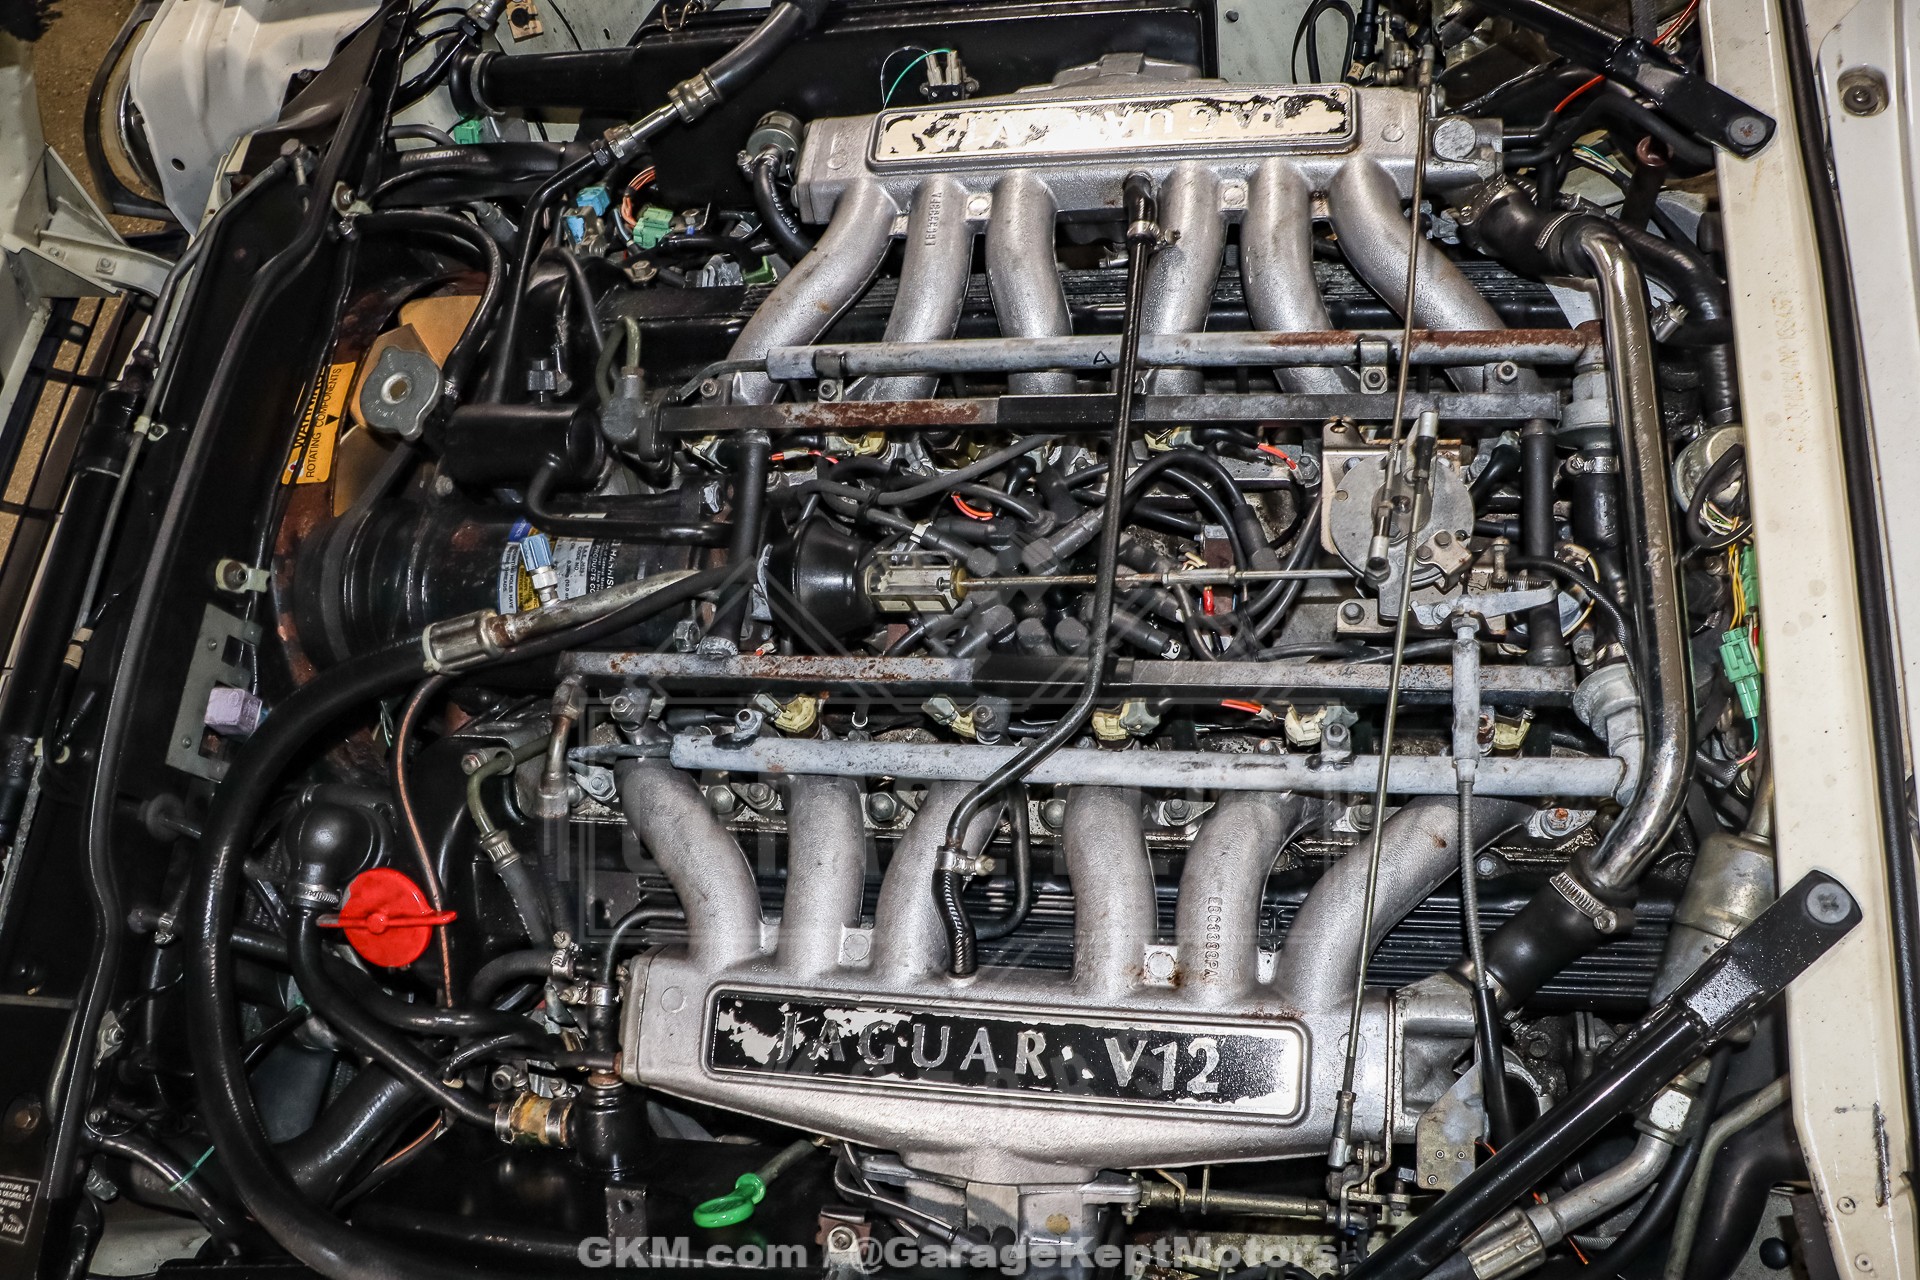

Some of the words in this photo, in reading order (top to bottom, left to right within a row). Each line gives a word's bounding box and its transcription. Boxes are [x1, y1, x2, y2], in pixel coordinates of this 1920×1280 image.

[306, 432, 322, 478] ROTATING
[315, 368, 342, 428] COMPONENTS
[590, 544, 601, 582] PRODUCTS
[779, 1011, 1049, 1080] JAGUAR
[1103, 1031, 1223, 1094] V12
